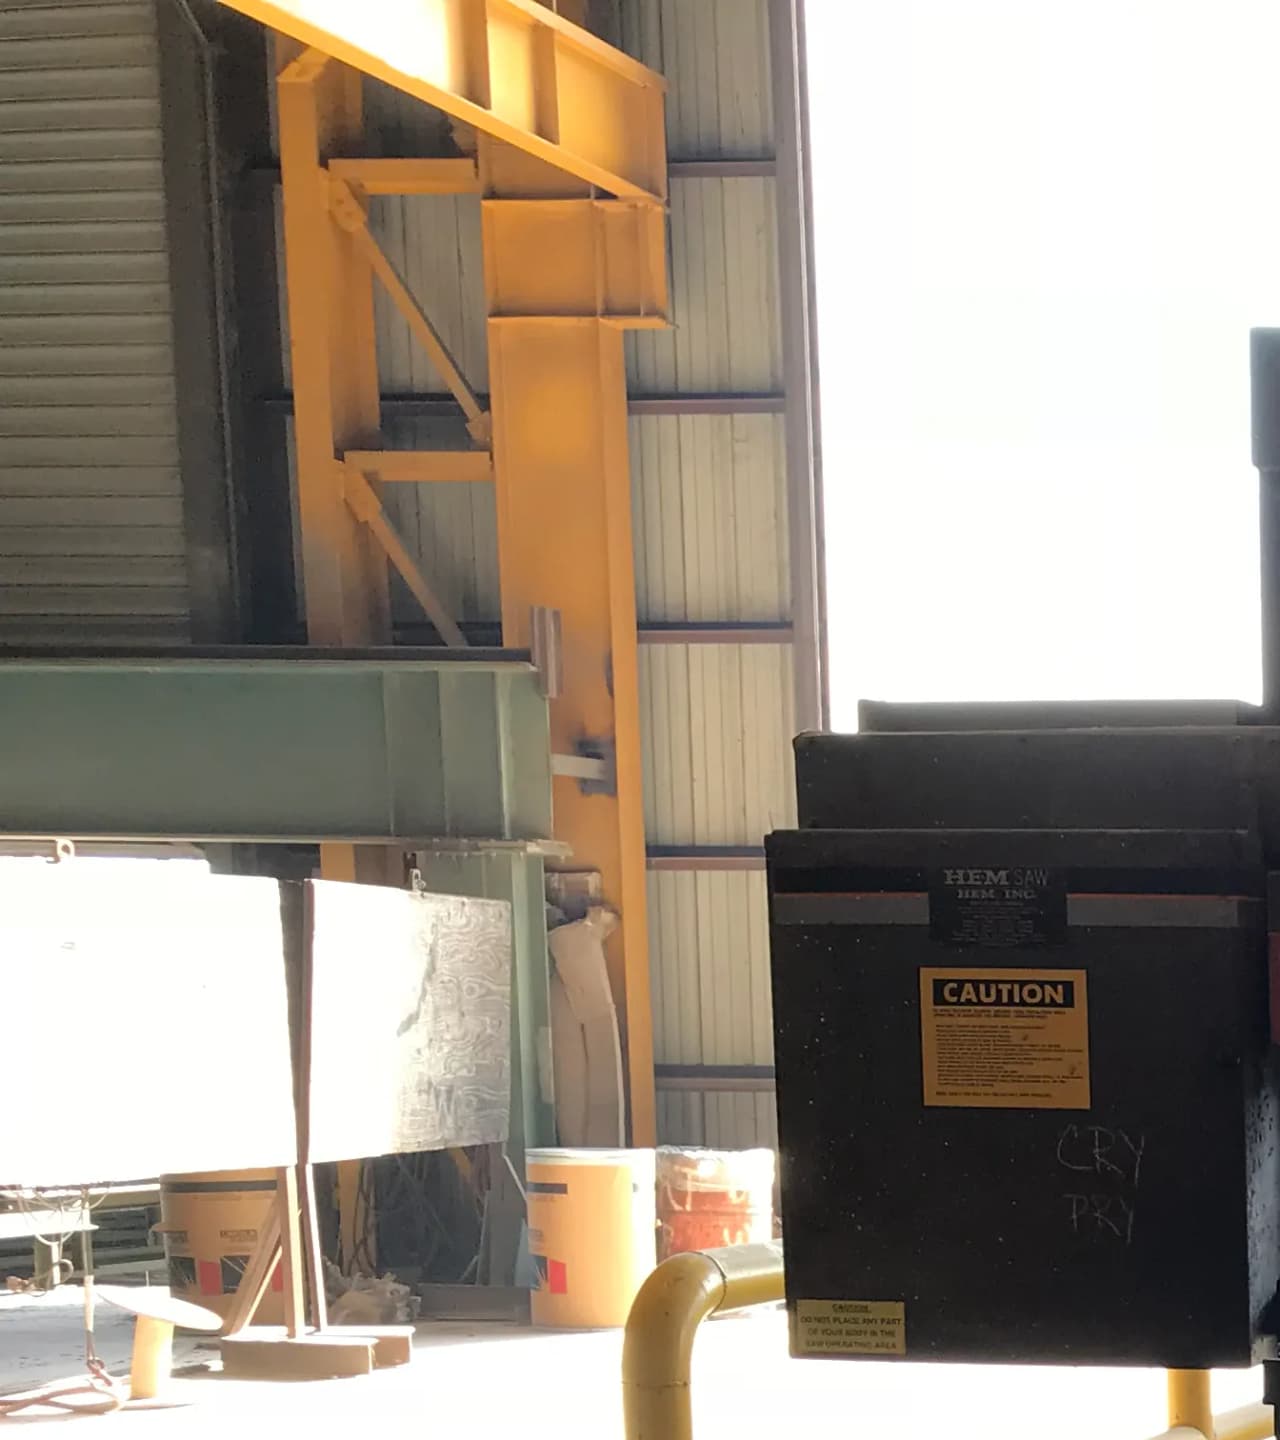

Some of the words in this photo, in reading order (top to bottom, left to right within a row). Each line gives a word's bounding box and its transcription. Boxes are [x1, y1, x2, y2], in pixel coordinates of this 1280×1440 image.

[943, 869, 1010, 886] HEM
[1013, 868, 1048, 887] SAW
[943, 983, 1064, 1004] CAUTION
